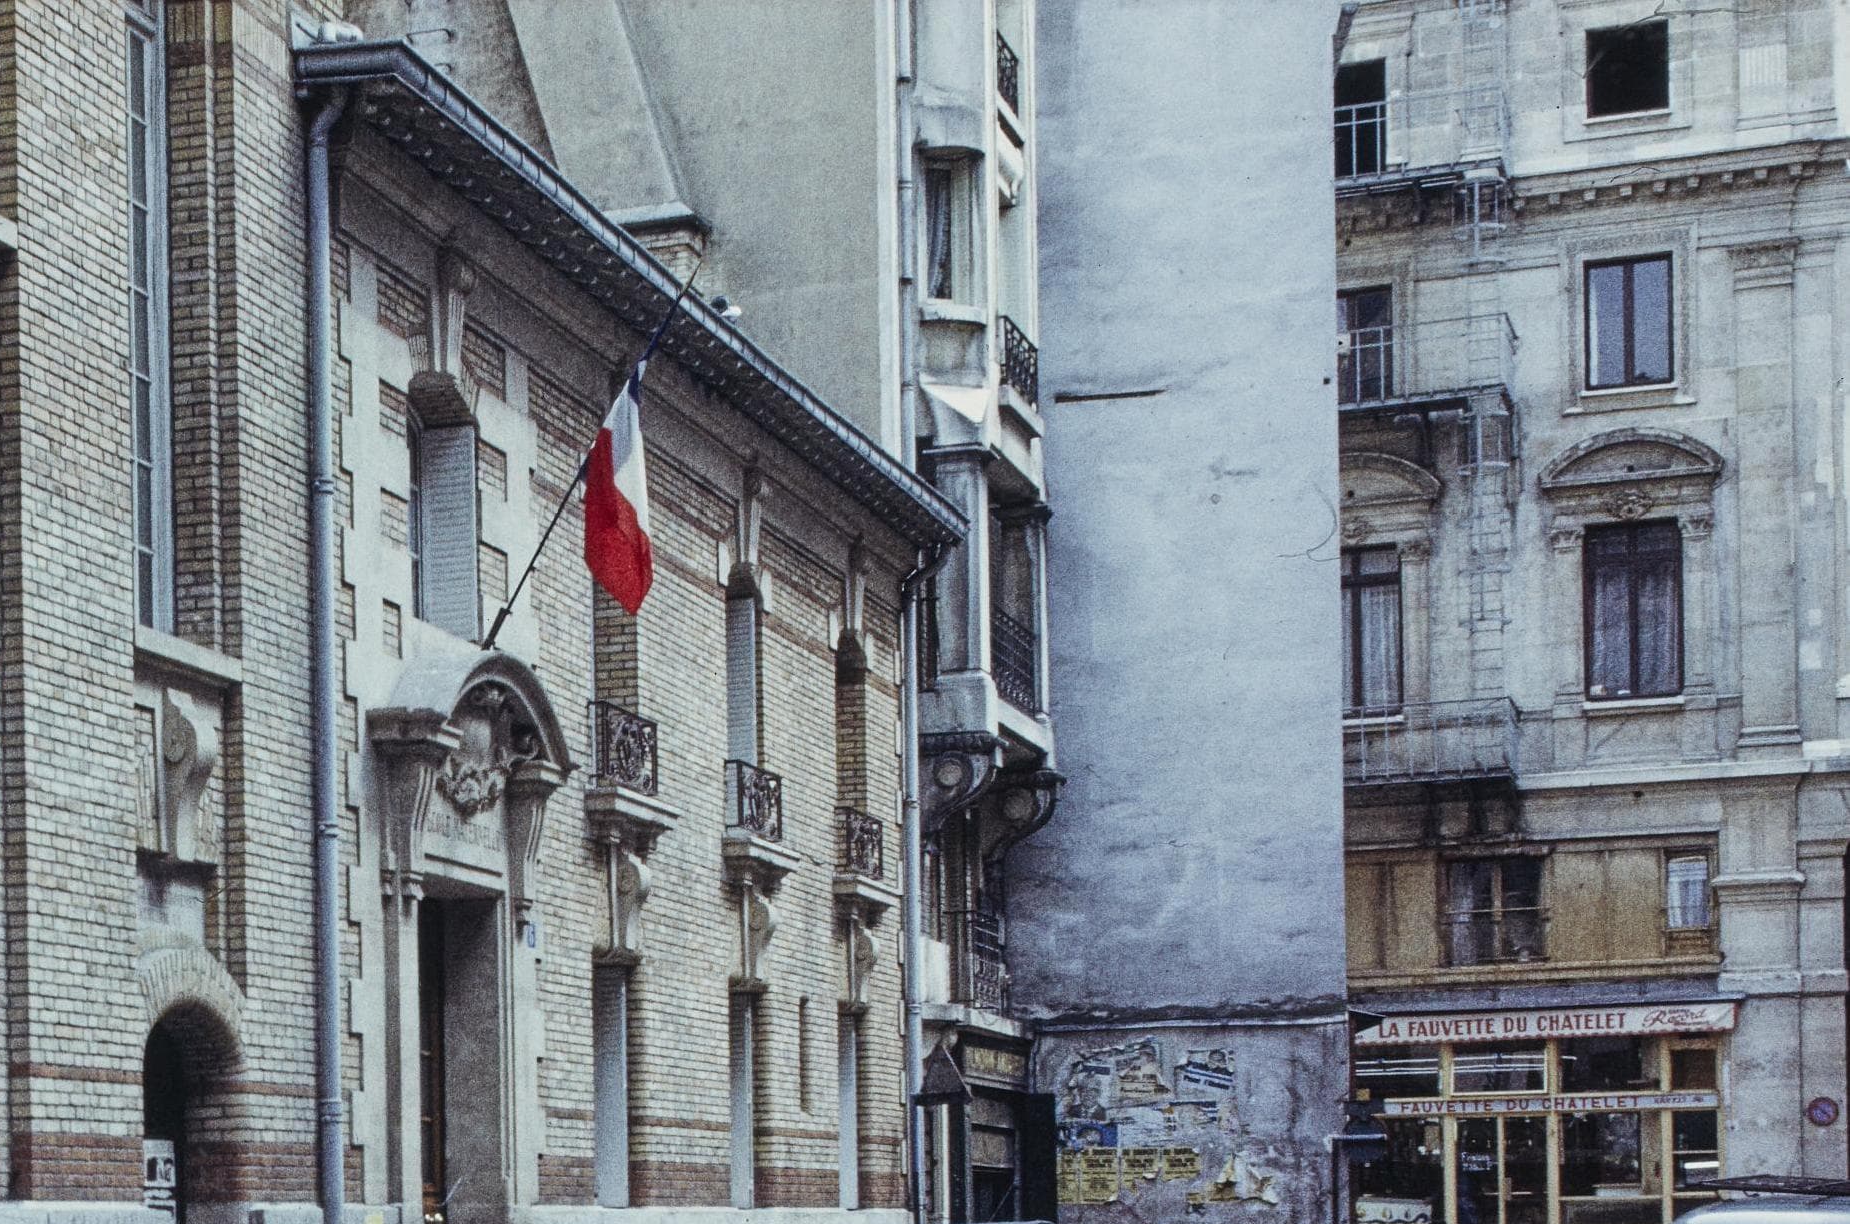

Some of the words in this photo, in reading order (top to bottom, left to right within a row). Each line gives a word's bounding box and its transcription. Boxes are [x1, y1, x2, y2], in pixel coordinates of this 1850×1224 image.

[1378, 1018, 1400, 1039] LA
[1407, 1016, 1496, 1038] FAUVETTE
[1502, 1015, 1527, 1034] DU
[1536, 1012, 1627, 1032] CHATELET
[1400, 1099, 1493, 1113] FAUVETTE
[1506, 1098, 1530, 1111] DU
[1542, 1095, 1640, 1110] CHATELET
